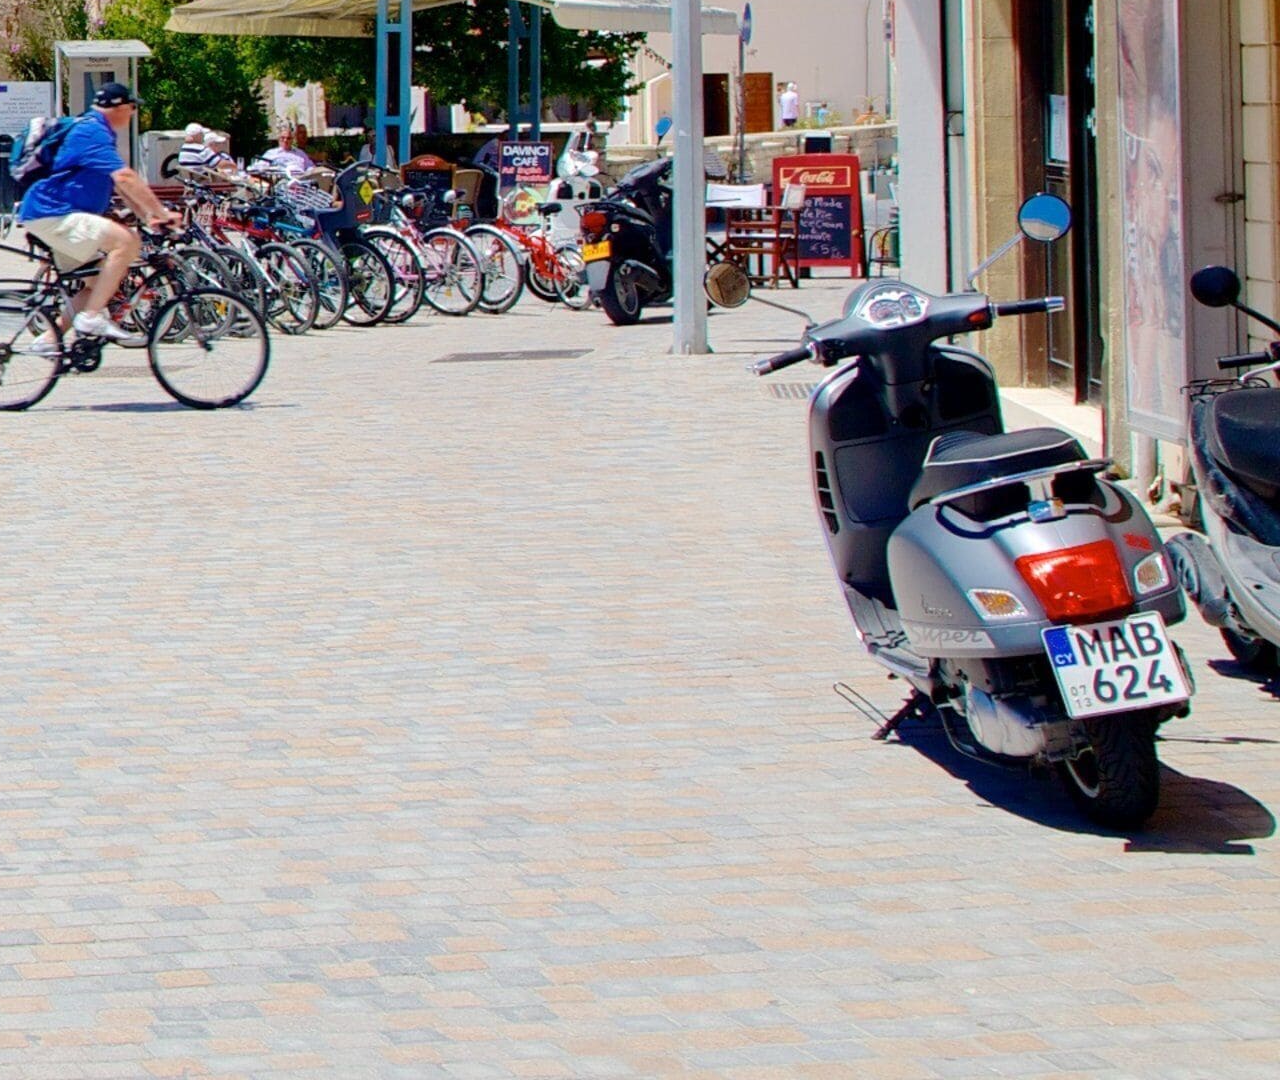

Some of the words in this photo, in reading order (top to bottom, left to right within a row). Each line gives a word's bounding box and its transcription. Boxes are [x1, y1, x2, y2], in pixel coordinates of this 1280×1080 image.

[1054, 653, 1073, 665] CY
[1075, 622, 1163, 666] MAB
[1093, 659, 1173, 704] 624
